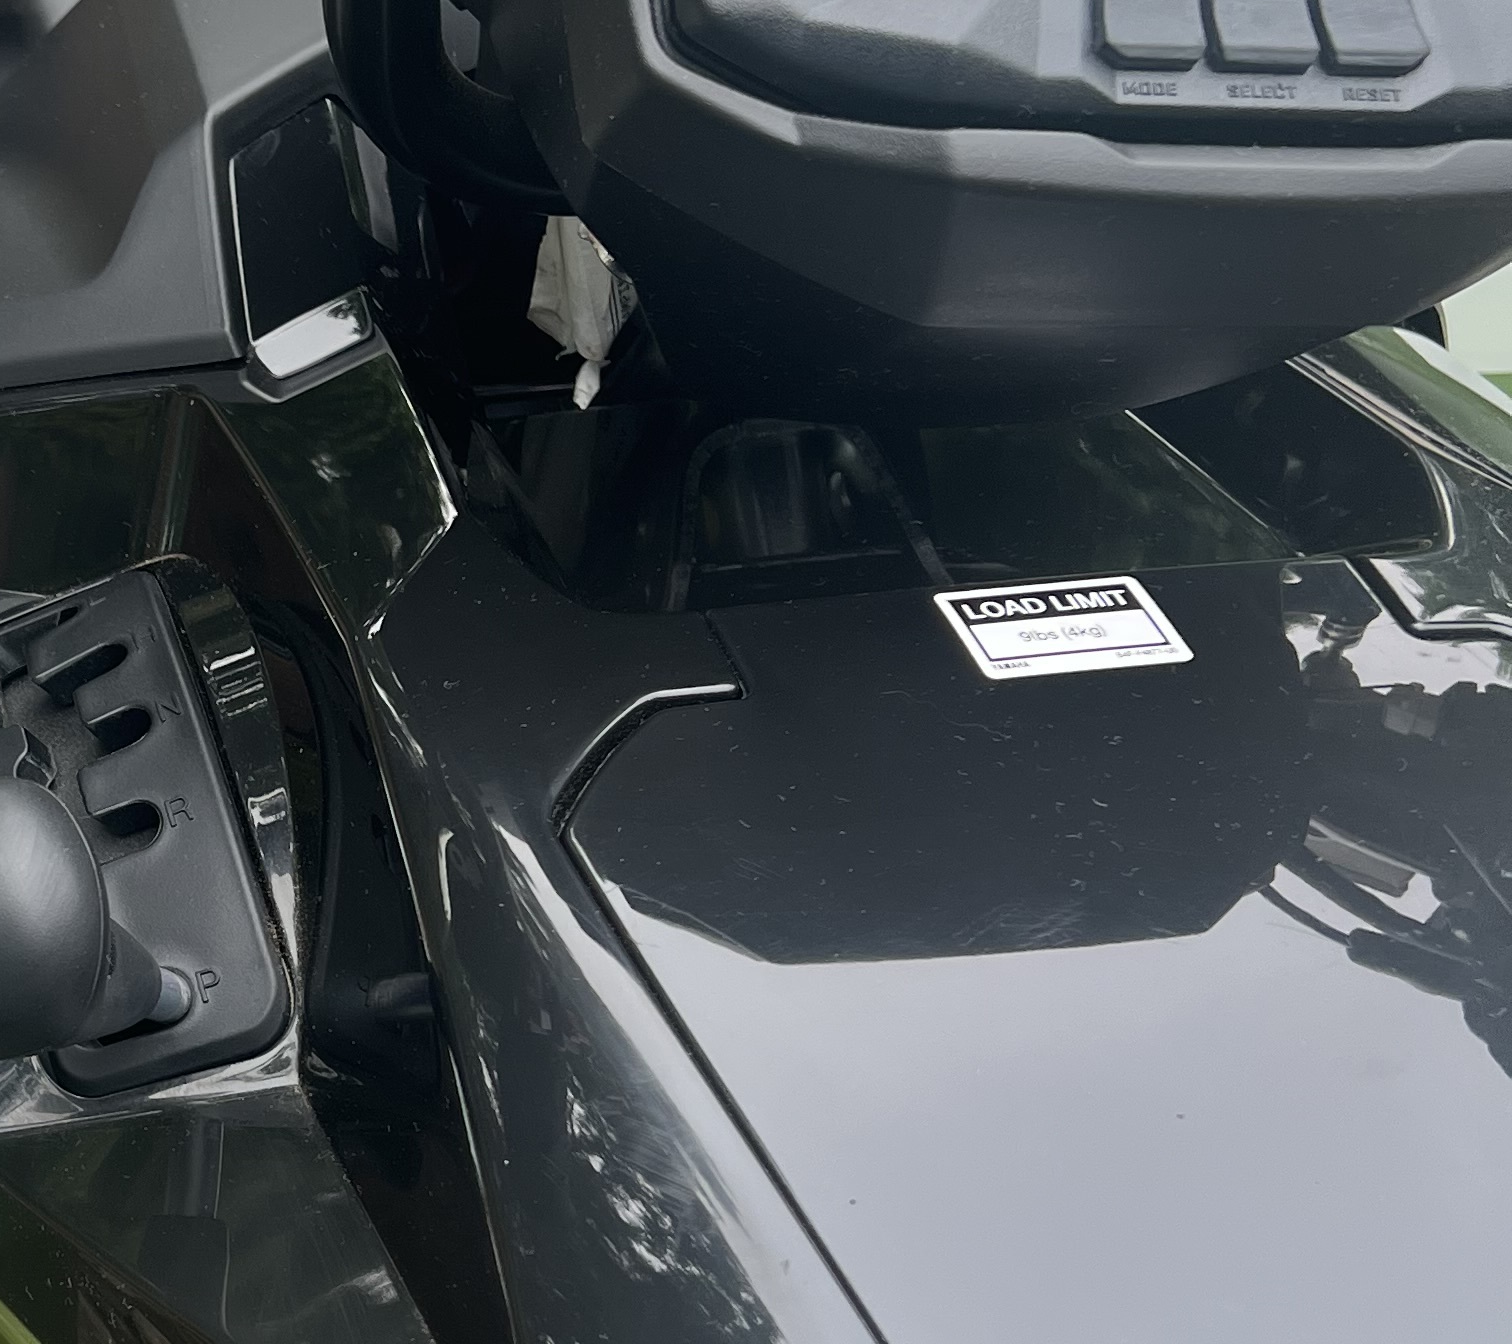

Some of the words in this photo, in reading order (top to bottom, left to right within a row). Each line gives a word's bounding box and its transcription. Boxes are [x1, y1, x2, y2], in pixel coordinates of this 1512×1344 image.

[1121, 80, 1178, 97] MODE
[1226, 83, 1297, 100] SELECT
[1341, 86, 1402, 102] RESET
[960, 596, 1048, 621] LOAD
[1048, 589, 1129, 613] LIMIT
[154, 697, 183, 724] N
[163, 796, 194, 829] R
[194, 967, 222, 1005] P
